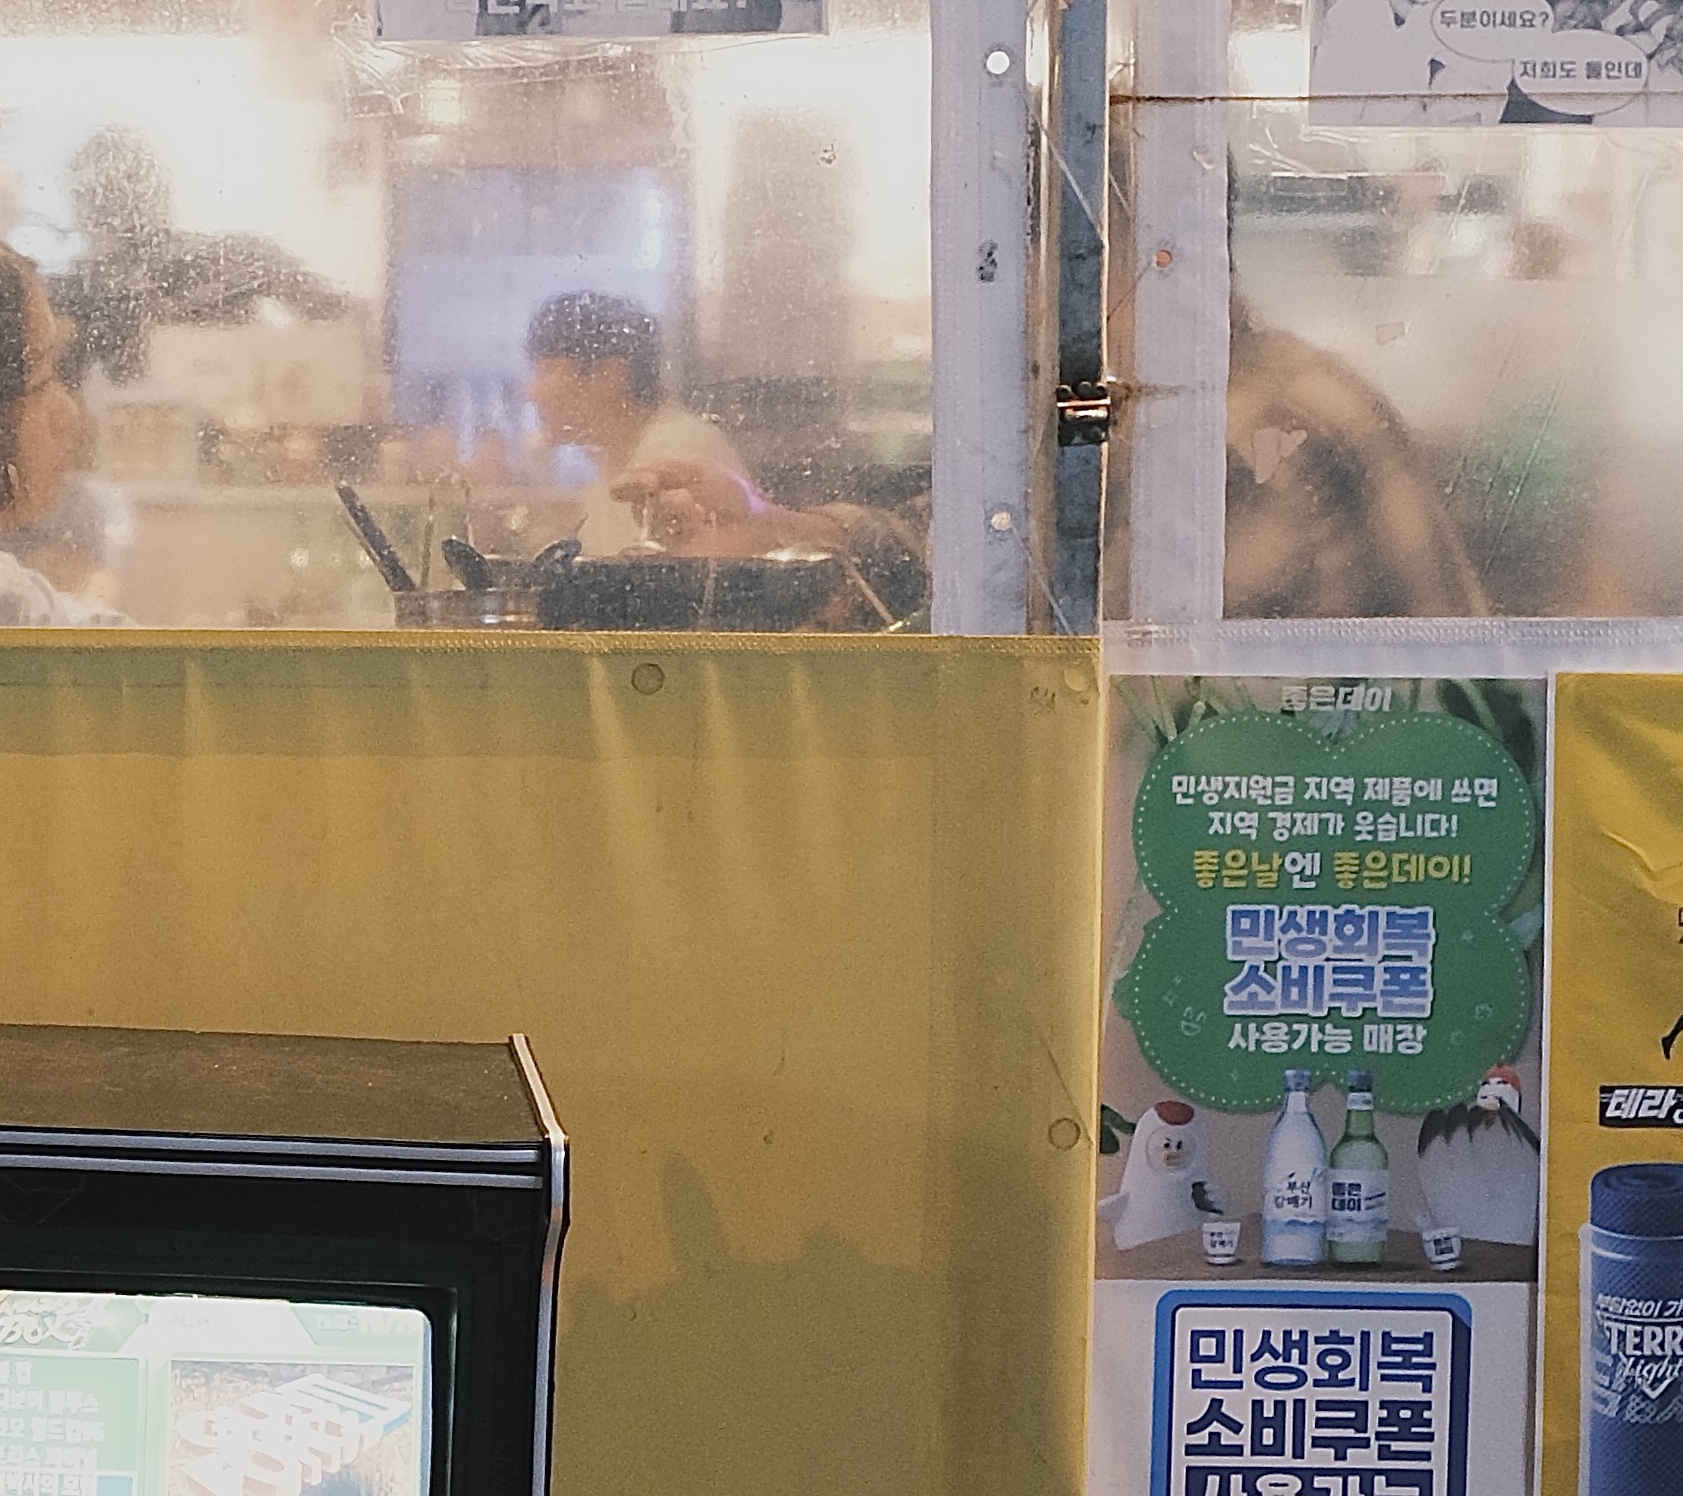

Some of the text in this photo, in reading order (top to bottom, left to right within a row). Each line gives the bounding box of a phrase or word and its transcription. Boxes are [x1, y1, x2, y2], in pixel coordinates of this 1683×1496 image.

[1439, 8, 1551, 30] 두분이세요?
[1519, 60, 1578, 80] 저희도
[1171, 775, 1499, 808] 민생지원금 지역 제품에 쓰면
[1208, 811, 1459, 842] 지역 경제가 웃습니다!
[1193, 849, 1473, 890] 좋은날엔 좋은데이!
[1227, 904, 1434, 962] 민생회복
[1224, 961, 1433, 1017] 소비쿠폰
[1228, 1022, 1428, 1054] 사용가능 매장
[1605, 1088, 1677, 1119] 테라
[1188, 1328, 1437, 1393] 민생회복
[1184, 1397, 1435, 1462] 소비쿠폰
